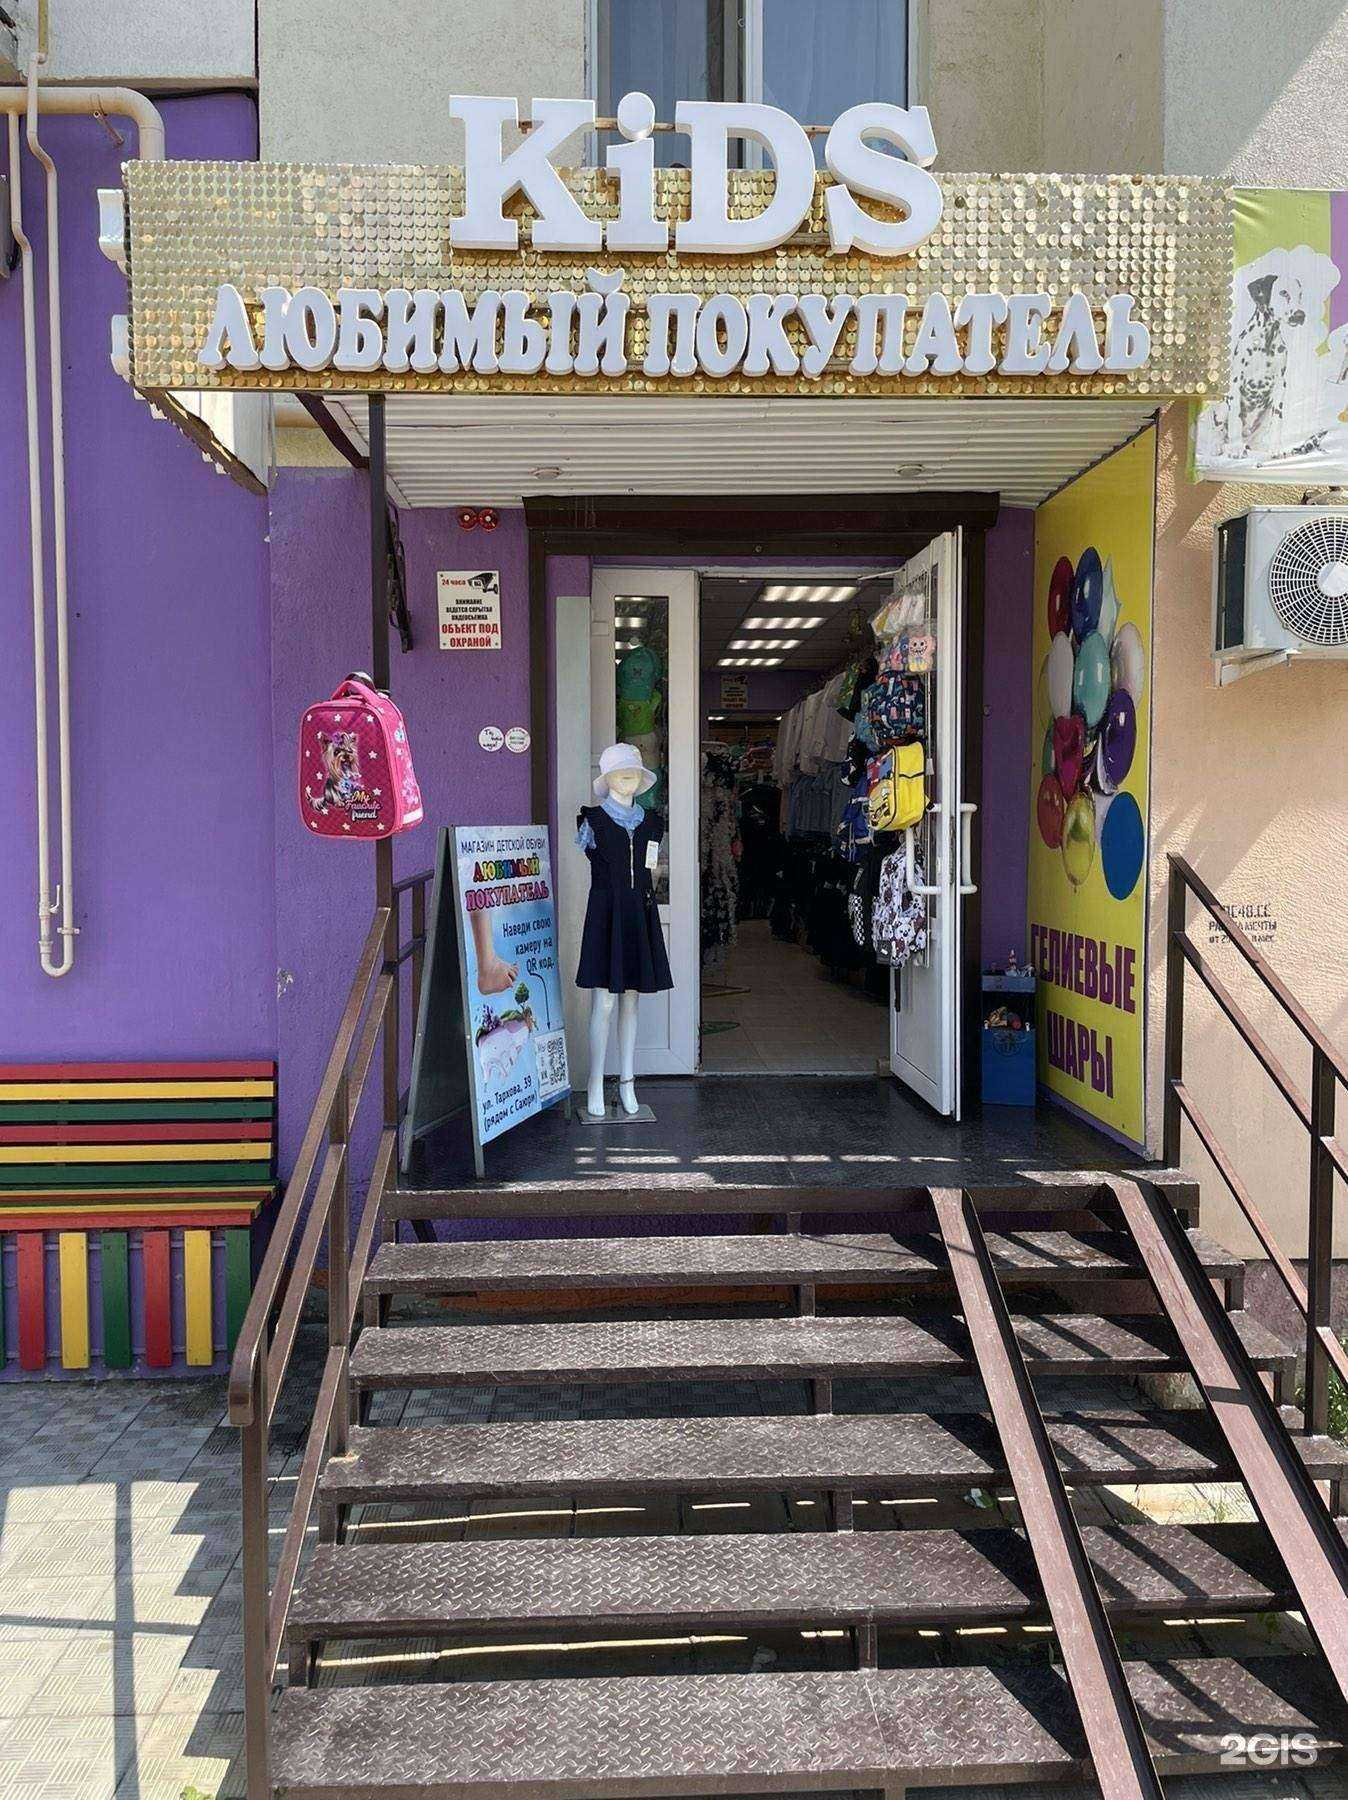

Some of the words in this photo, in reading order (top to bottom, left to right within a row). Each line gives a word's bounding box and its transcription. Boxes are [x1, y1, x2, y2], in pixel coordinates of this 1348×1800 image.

[449, 92, 944, 256] KiDS
[198, 268, 630, 377] ЛЮБИМЫЙ
[642, 292, 1151, 378] ПОКУПАТЕЛЬ
[441, 623, 477, 634] ОБЪЕКТ
[480, 623, 499, 635] ПОД
[450, 635, 492, 648] ОХРАНОЙ
[461, 840, 495, 854] МАГАЗИН
[497, 836, 525, 852] ДЕТСКОЙ
[526, 838, 546, 850] ОБУВИ
[473, 852, 540, 883] ЛЮБИМЫЙ
[465, 880, 550, 911] ПОКУПАТЕЛЬ
[502, 921, 531, 938] Наведи
[532, 917, 552, 931] свою
[515, 939, 542, 956] камеру
[543, 936, 553, 948] на
[1031, 923, 1136, 1015] ГЕЛИЕВЫЕ
[1046, 1010, 1114, 1099] ШАРЫ
[524, 1074, 532, 1089] 39
[484, 1107, 509, 1132] (рядом
